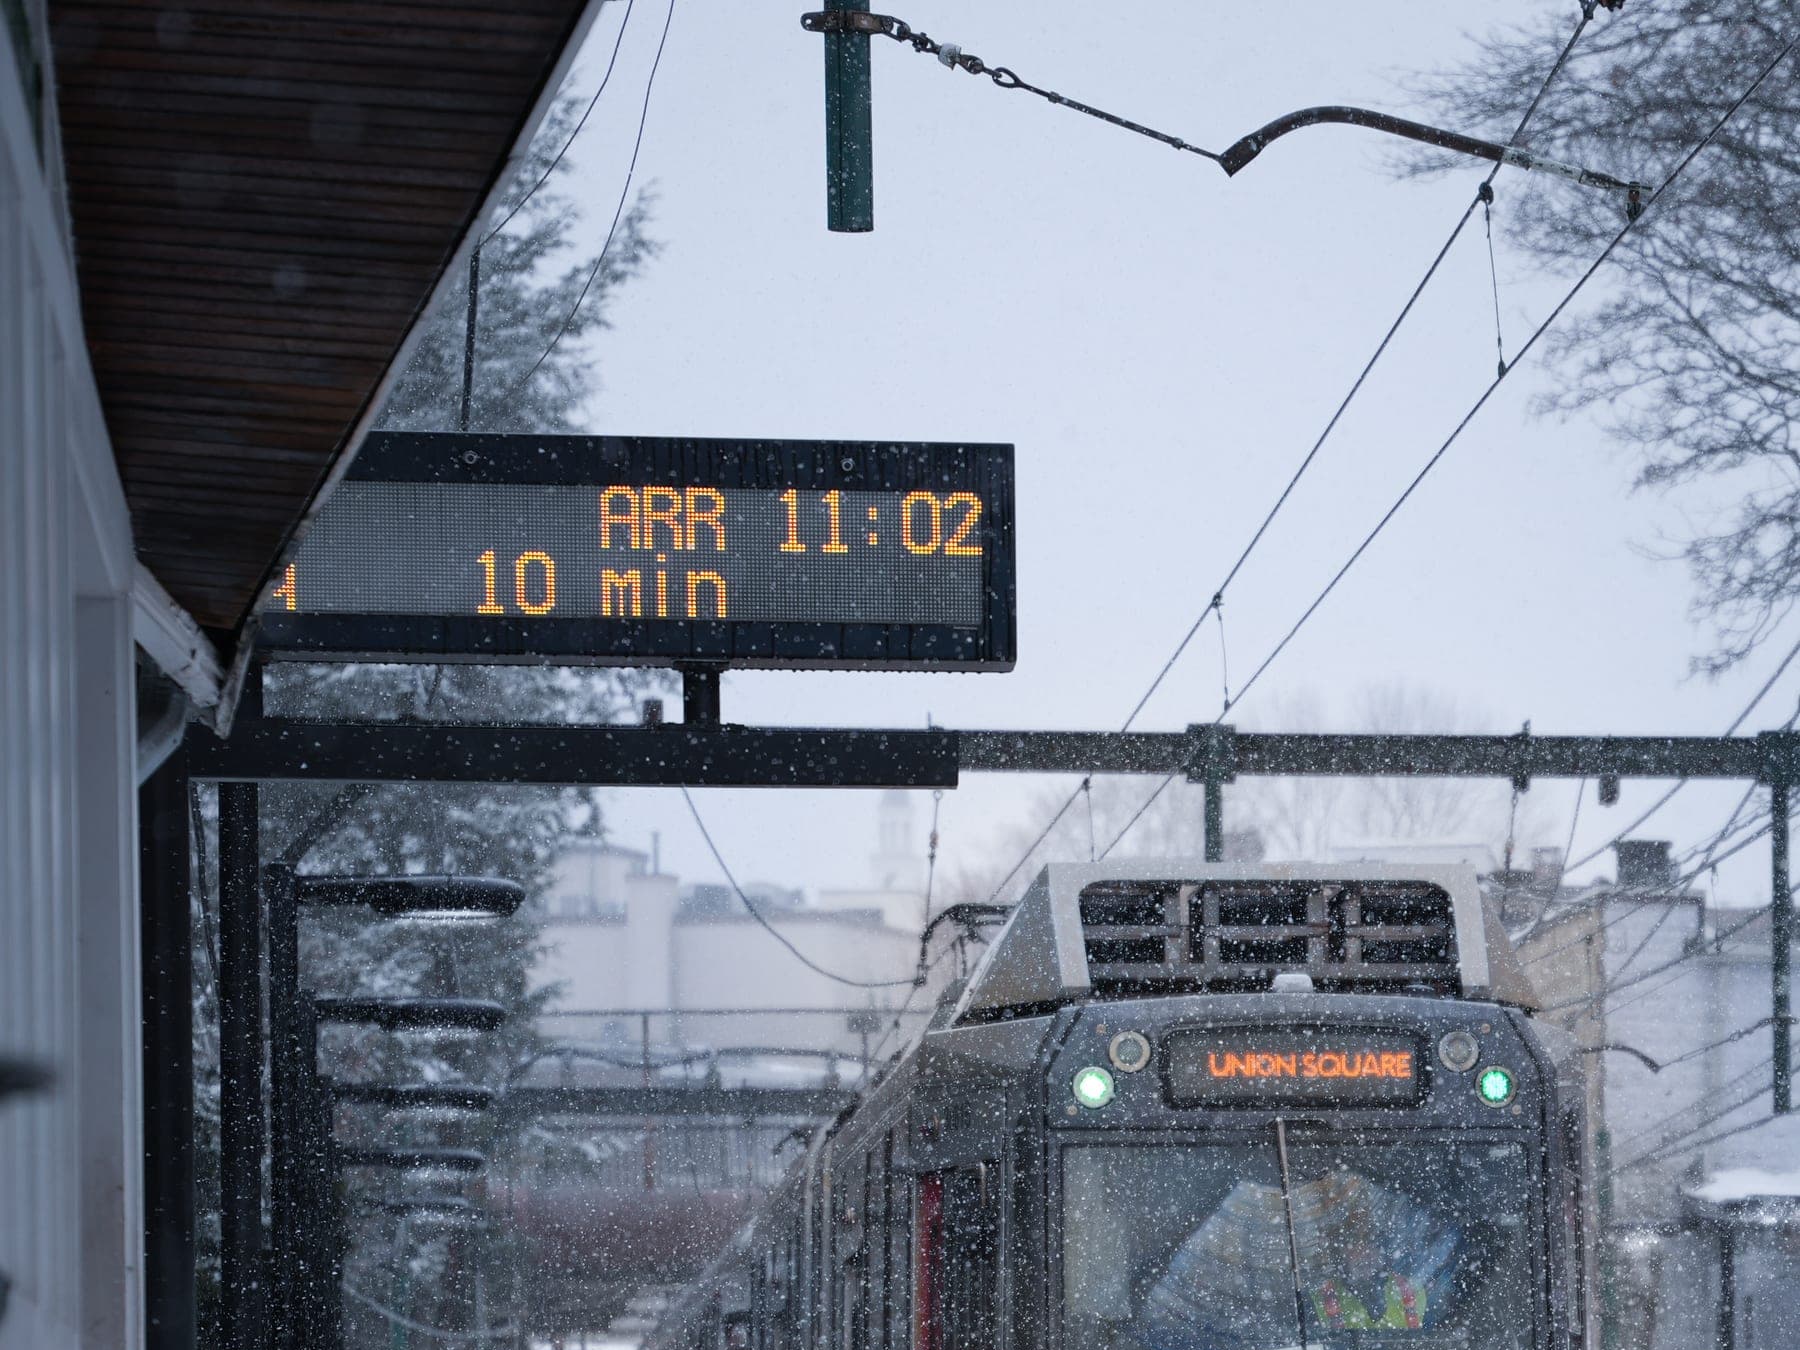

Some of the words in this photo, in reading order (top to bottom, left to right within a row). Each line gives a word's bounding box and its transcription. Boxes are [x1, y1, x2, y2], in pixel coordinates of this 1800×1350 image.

[600, 485, 725, 551] ARR
[780, 489, 983, 556] 11:02
[477, 551, 556, 615] 10
[601, 555, 728, 619] min
[1208, 1052, 1297, 1078] UNION
[1302, 1052, 1411, 1078] SQUARE
